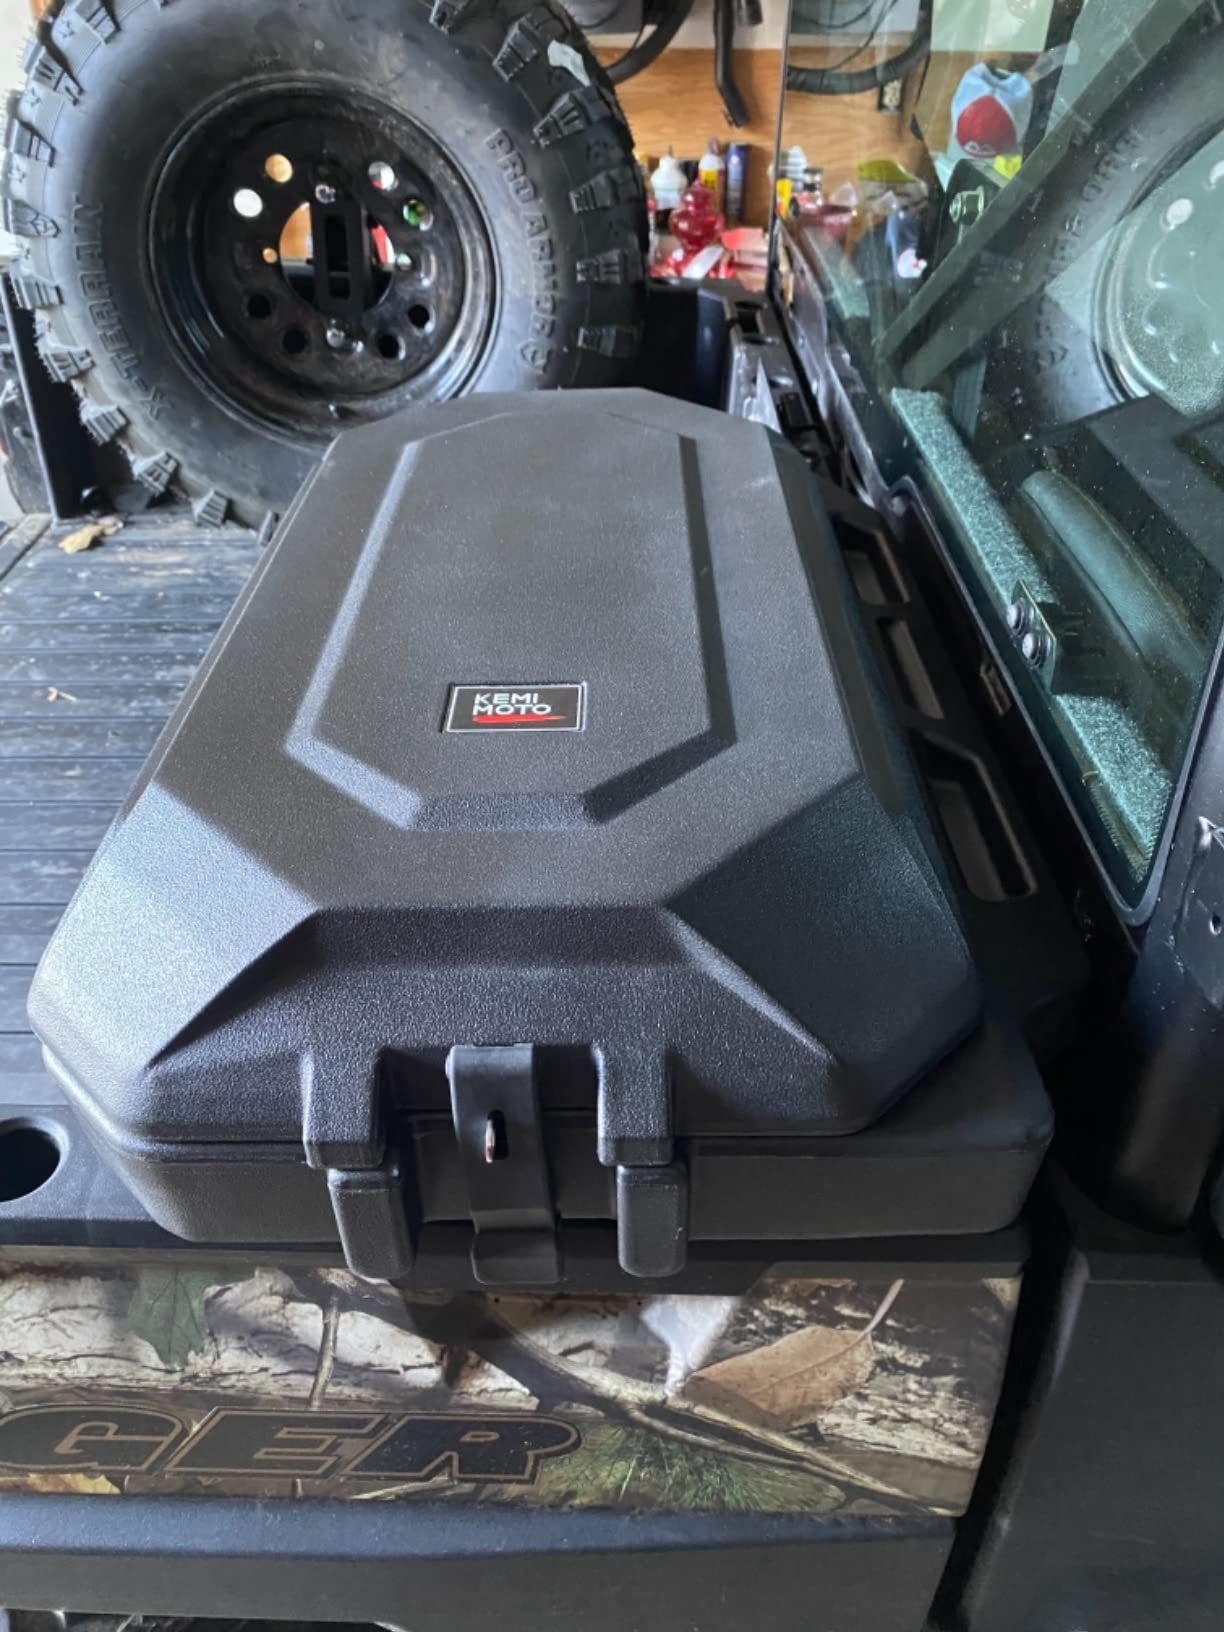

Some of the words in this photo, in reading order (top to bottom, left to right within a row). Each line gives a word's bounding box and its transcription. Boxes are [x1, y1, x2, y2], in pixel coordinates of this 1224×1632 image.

[483, 128, 537, 206] PRO
[521, 212, 557, 339] ARMOR
[474, 692, 539, 705] KEMI
[472, 703, 552, 716] MOTO
